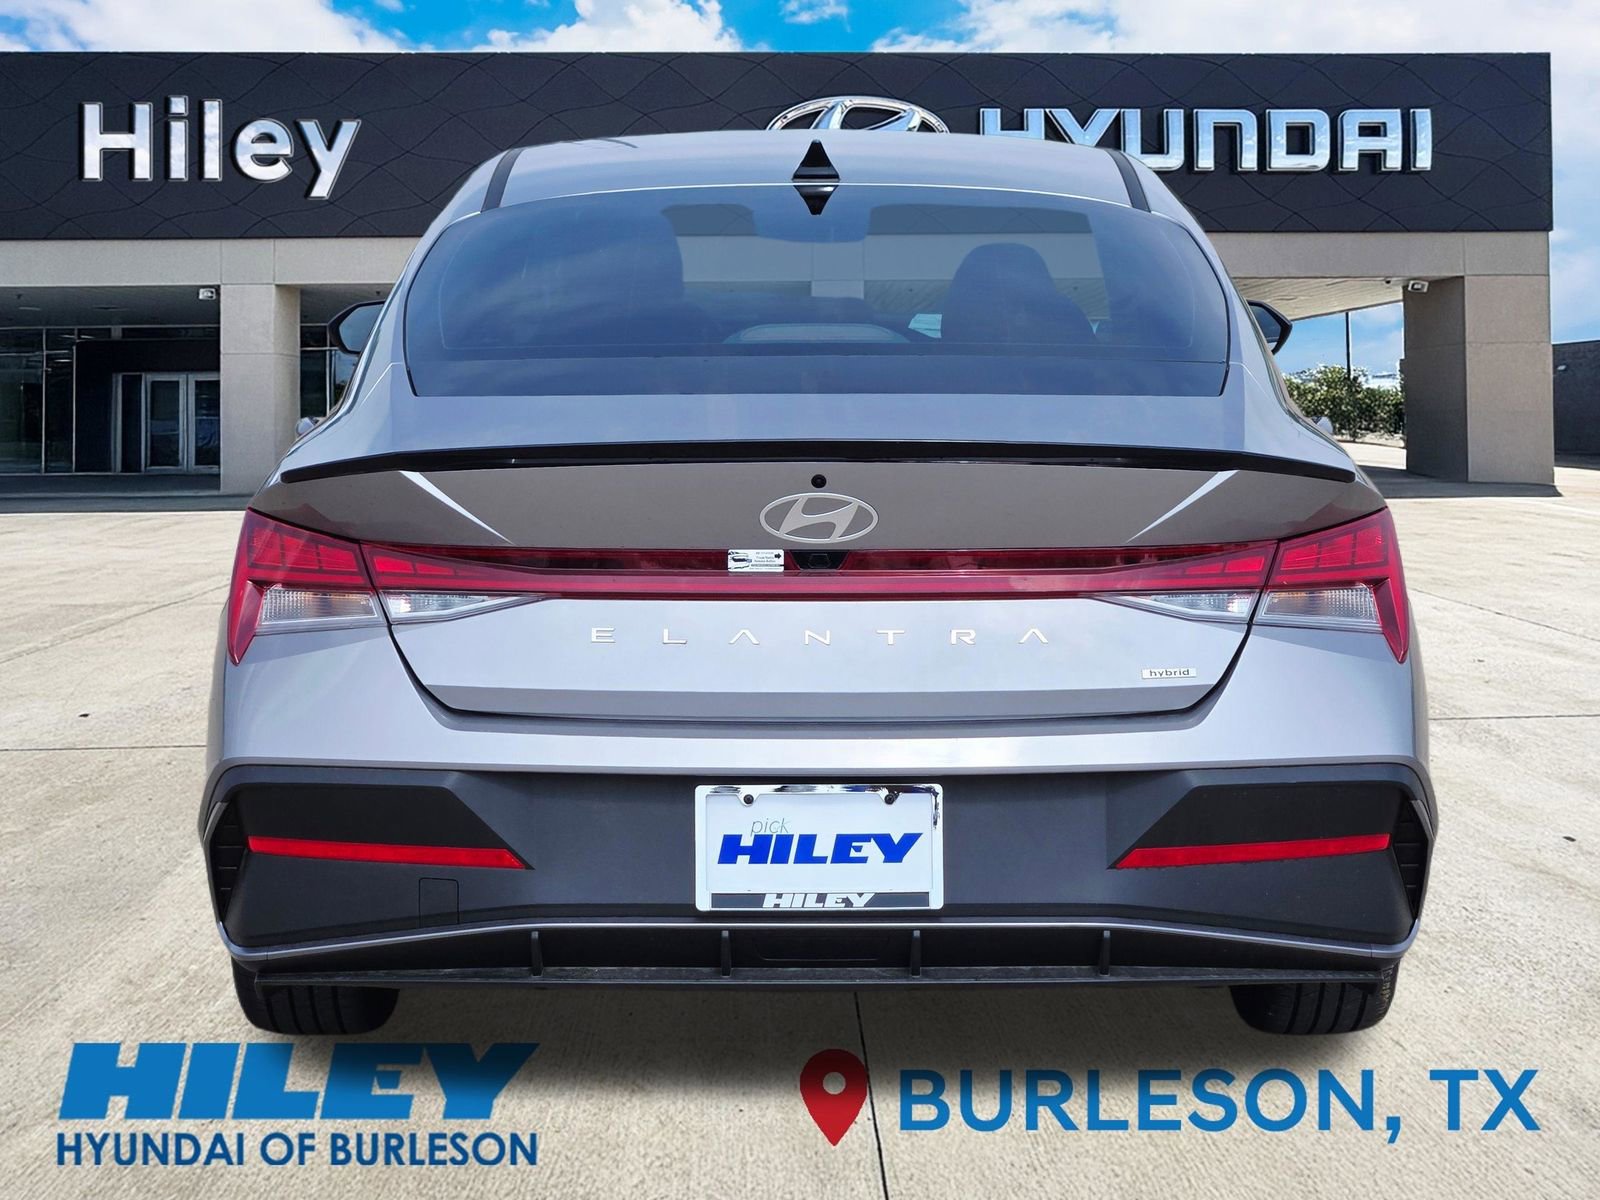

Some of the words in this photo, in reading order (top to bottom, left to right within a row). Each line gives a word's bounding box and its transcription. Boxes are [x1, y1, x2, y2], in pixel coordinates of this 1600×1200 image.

[80, 95, 361, 200] Hiley
[590, 626, 1050, 646] ELANTRA
[1149, 668, 1191, 678] hybrid
[750, 817, 790, 837] pick
[717, 832, 924, 865] HILEY
[762, 892, 876, 909] HILEY
